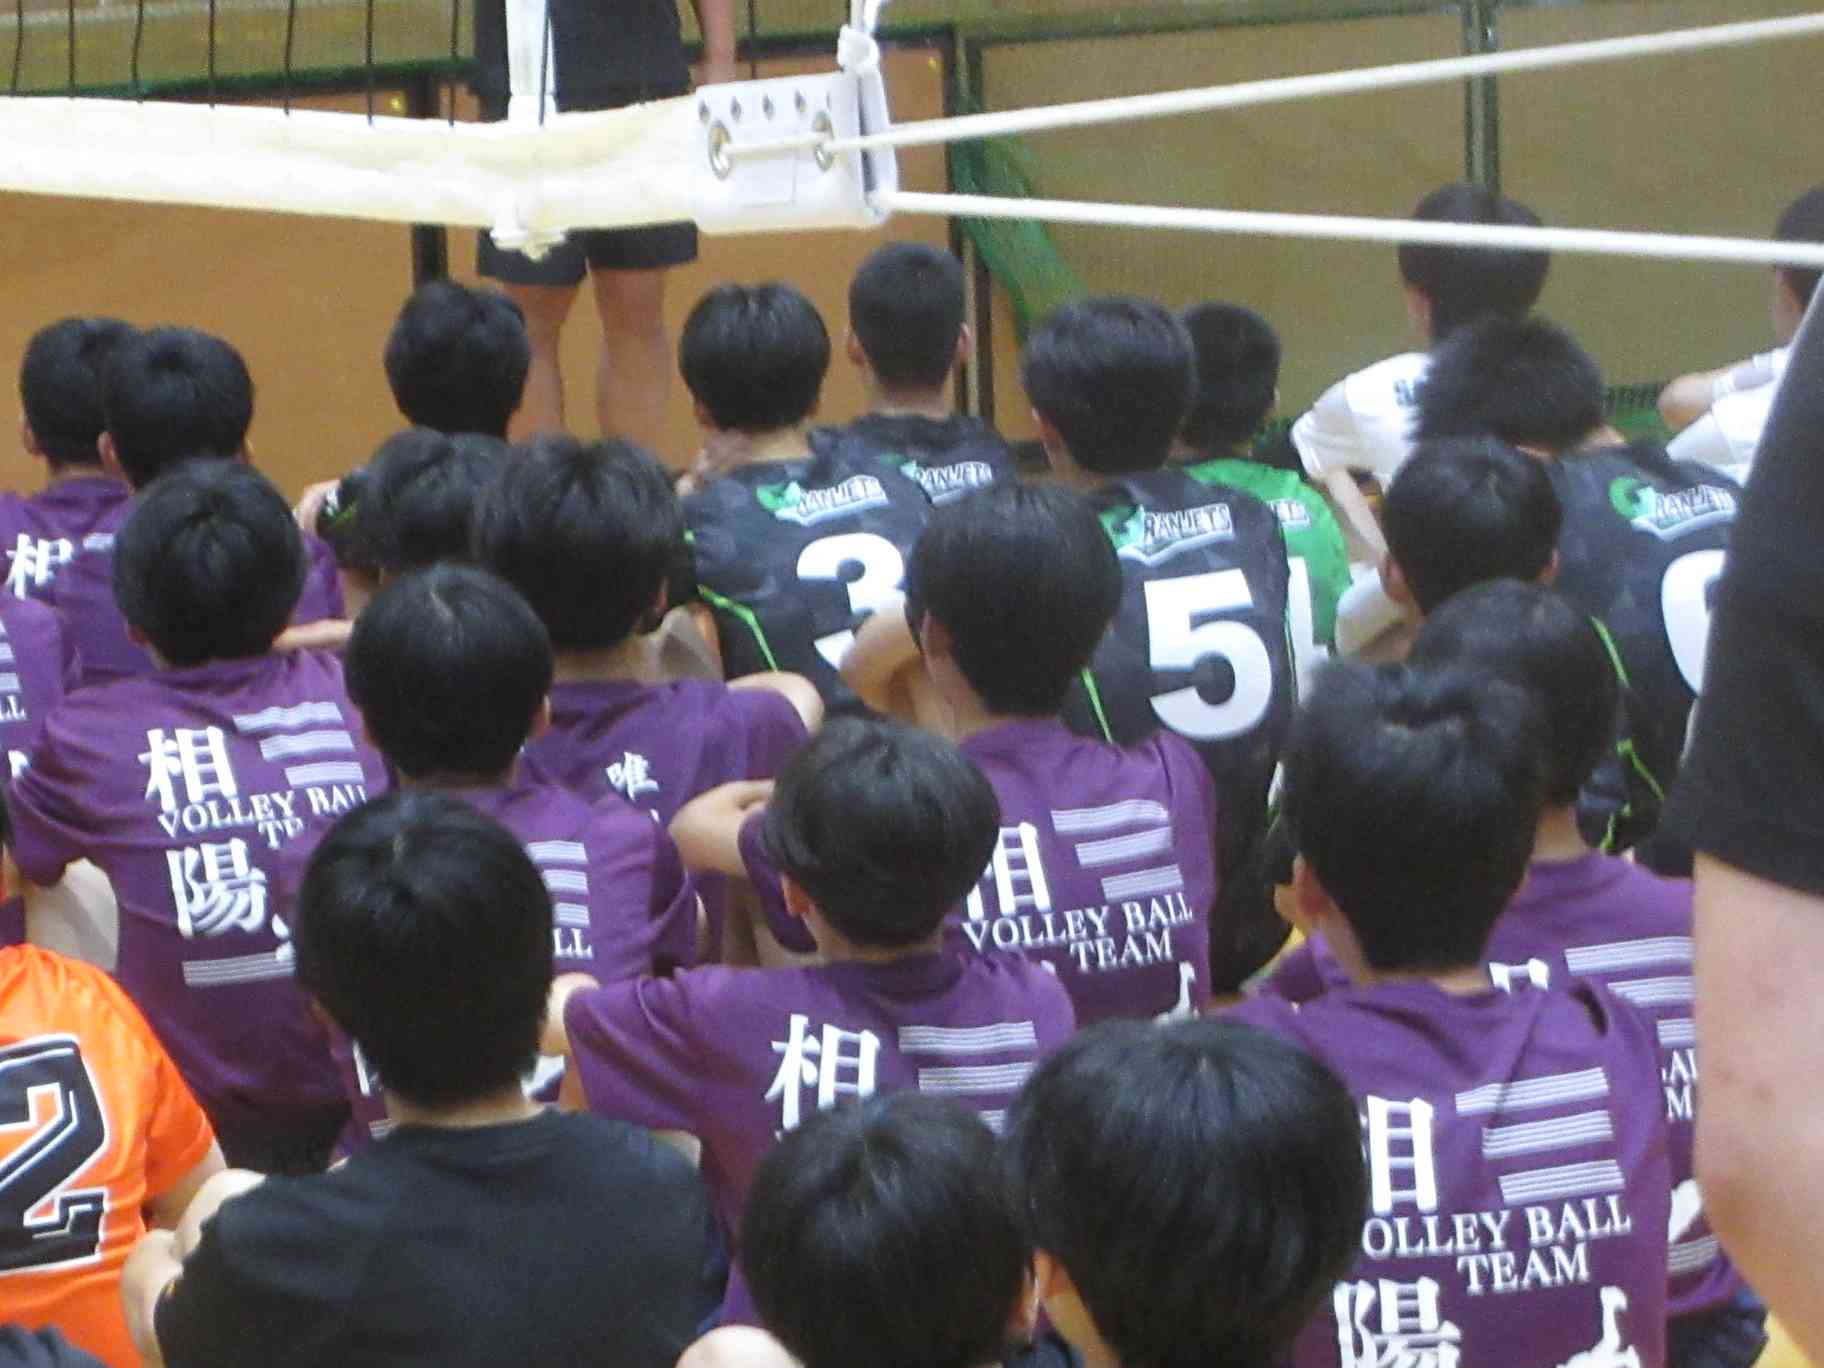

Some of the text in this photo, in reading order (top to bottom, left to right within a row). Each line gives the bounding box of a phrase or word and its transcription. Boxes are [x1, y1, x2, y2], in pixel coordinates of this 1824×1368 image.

[1144, 568, 1272, 742] 5
[137, 725, 238, 814] 相
[157, 788, 294, 839] VOLLEY
[166, 836, 267, 940] 陽
[961, 891, 1194, 951] VOLLEY BALL
[1068, 927, 1173, 973] TEAM
[764, 1013, 881, 1132] 相
[1363, 1193, 1633, 1262] OLLEY BALL
[1456, 1242, 1591, 1297] TEAM
